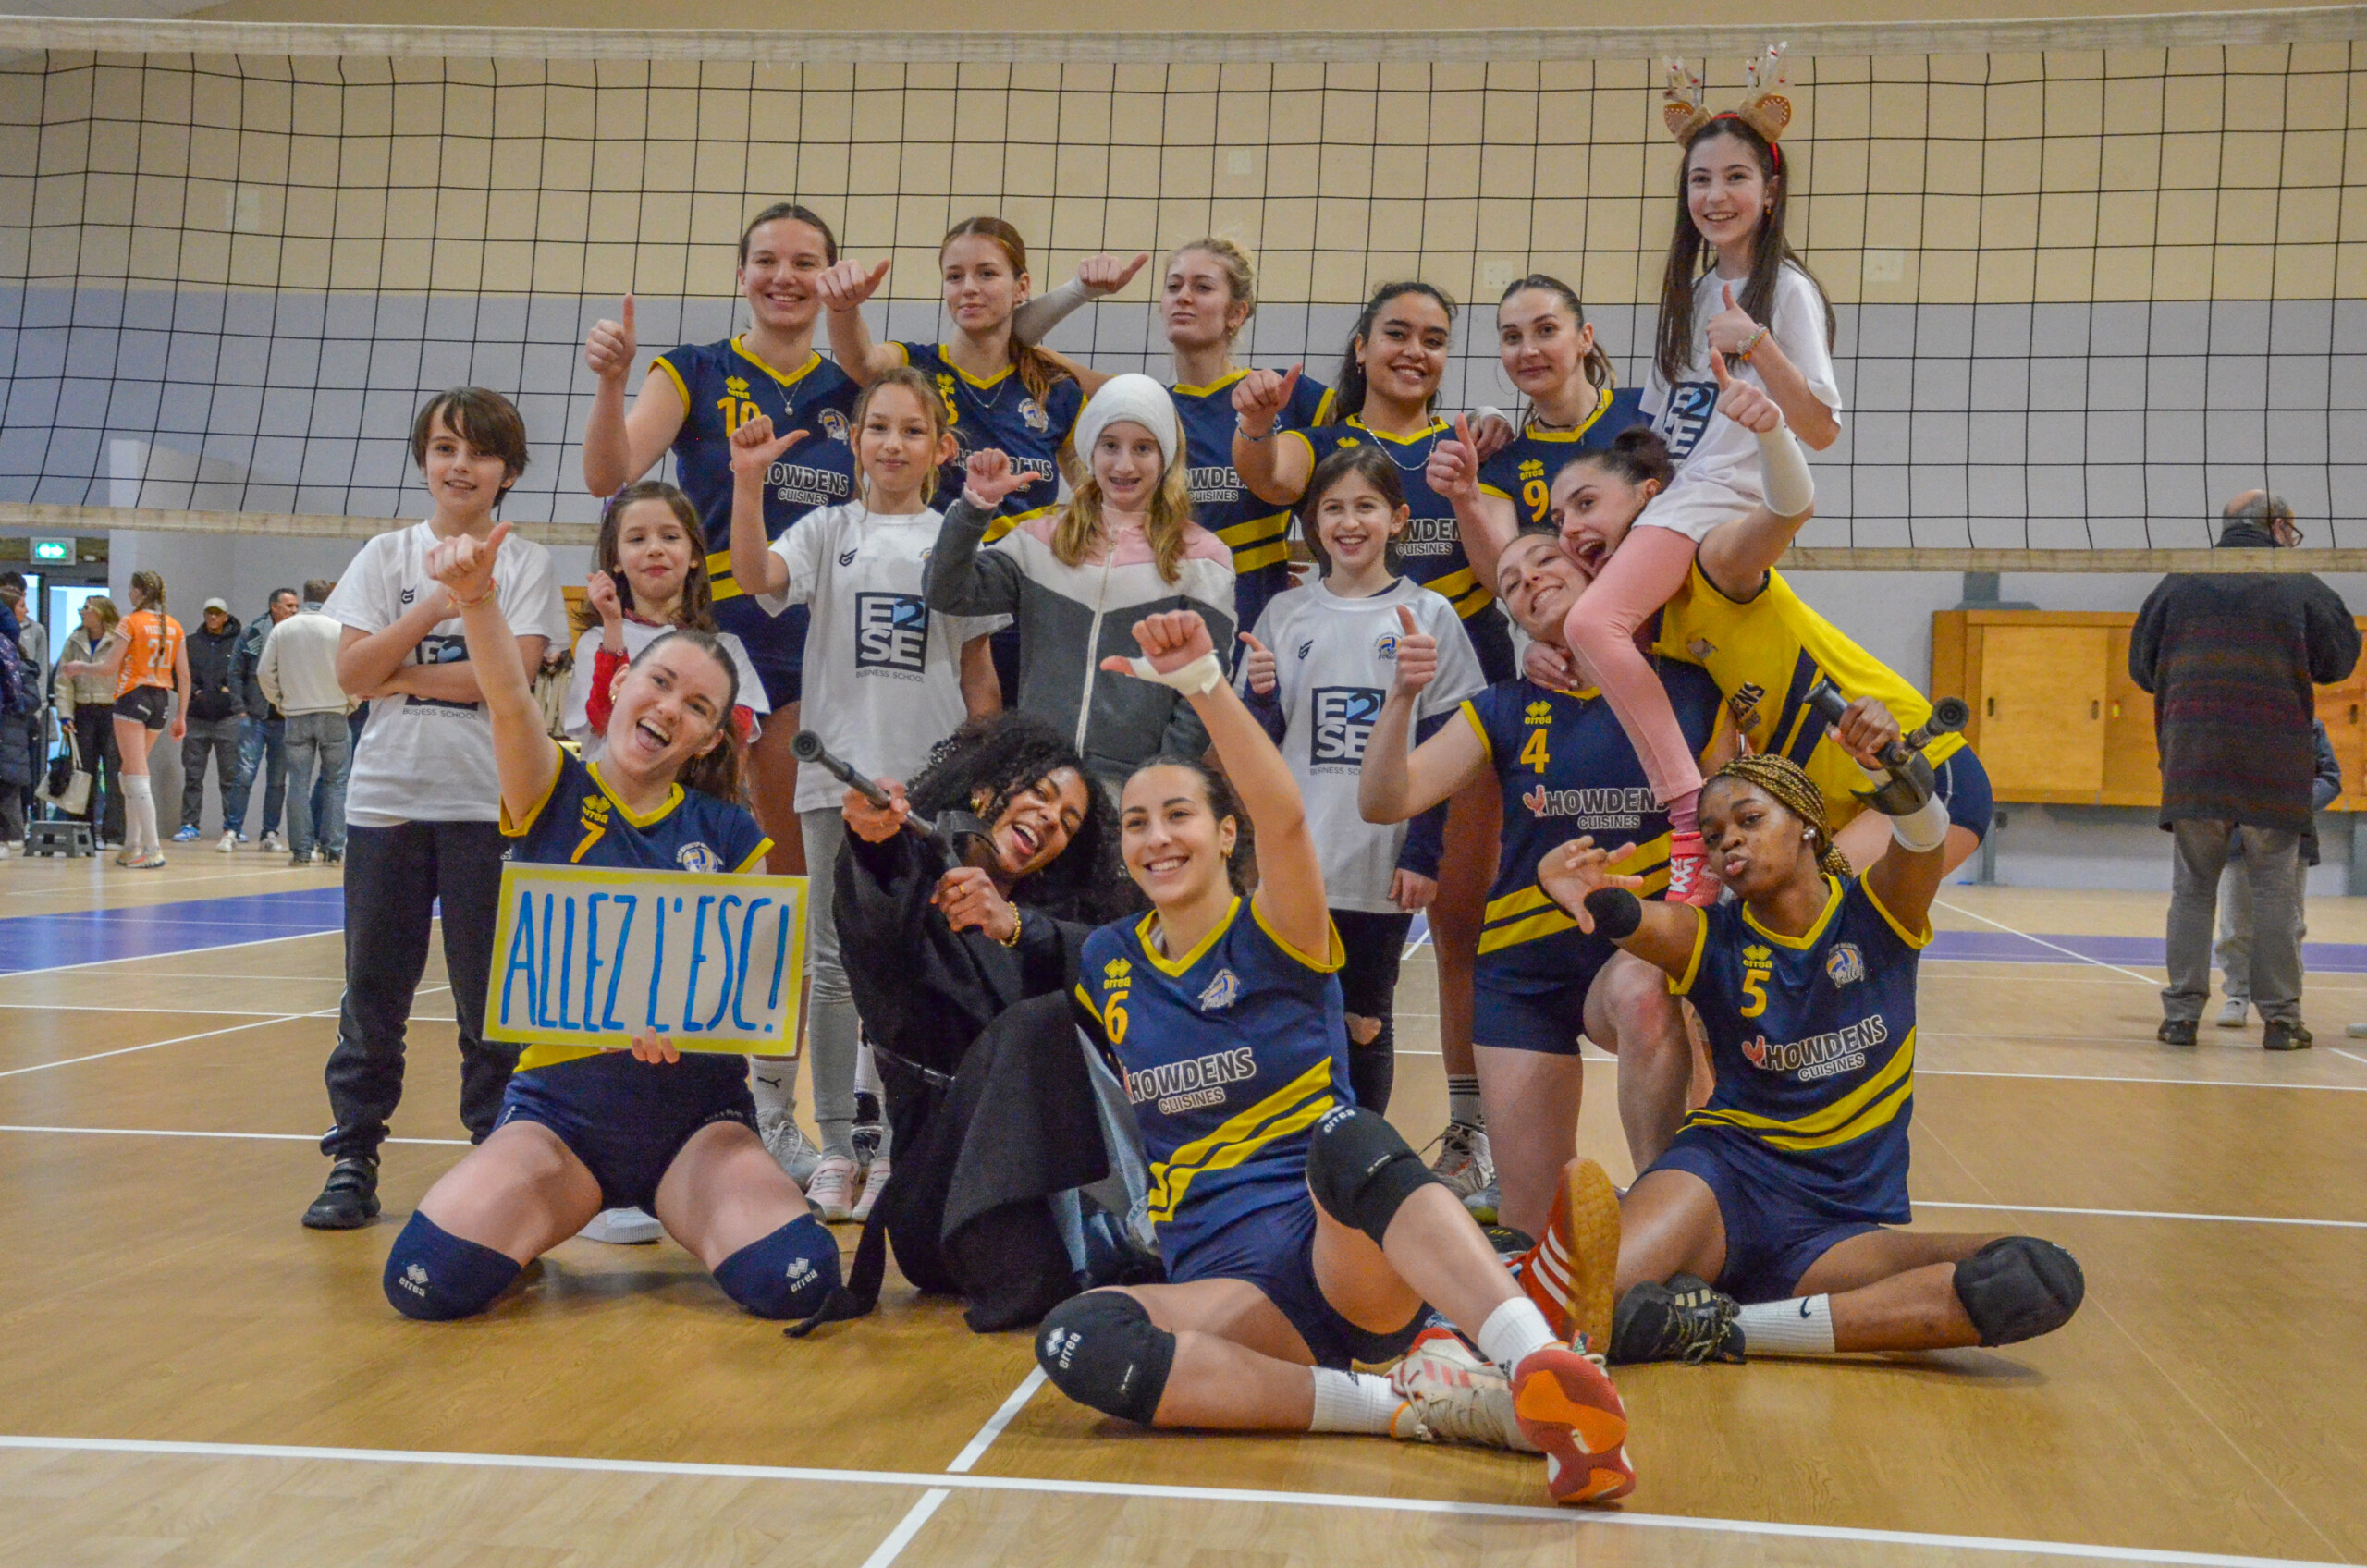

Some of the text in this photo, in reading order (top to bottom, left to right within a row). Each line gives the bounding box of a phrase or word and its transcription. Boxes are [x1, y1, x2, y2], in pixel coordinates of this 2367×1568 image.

[778, 487, 829, 506] CUISINES
[1522, 479, 1550, 523] 9
[1395, 542, 1453, 556] CUISINES
[861, 596, 926, 630] E2
[860, 628, 925, 667] SE
[893, 671, 926, 683] SCHOOL
[440, 710, 478, 720] SCHOOL
[1317, 692, 1380, 726] E2
[1524, 715, 1552, 725] errea
[1519, 728, 1551, 774] 4
[1577, 815, 1641, 830] CUISINES
[570, 815, 607, 864] 7
[500, 890, 638, 1033] ALLEZ
[1742, 959, 1773, 969] errea
[1103, 977, 1132, 990] errea
[1739, 968, 1772, 1018] 5
[1103, 990, 1129, 1045] 6
[1764, 1014, 1888, 1072] HOWDENS
[1129, 1047, 1257, 1102] HOWDENS
[1798, 1053, 1866, 1082] CUISINES
[1158, 1086, 1226, 1115] CUISINES
[1323, 1109, 1356, 1134] errea
[399, 1277, 425, 1297] errea
[790, 1268, 818, 1292] errea
[1058, 1331, 1082, 1369] errea
